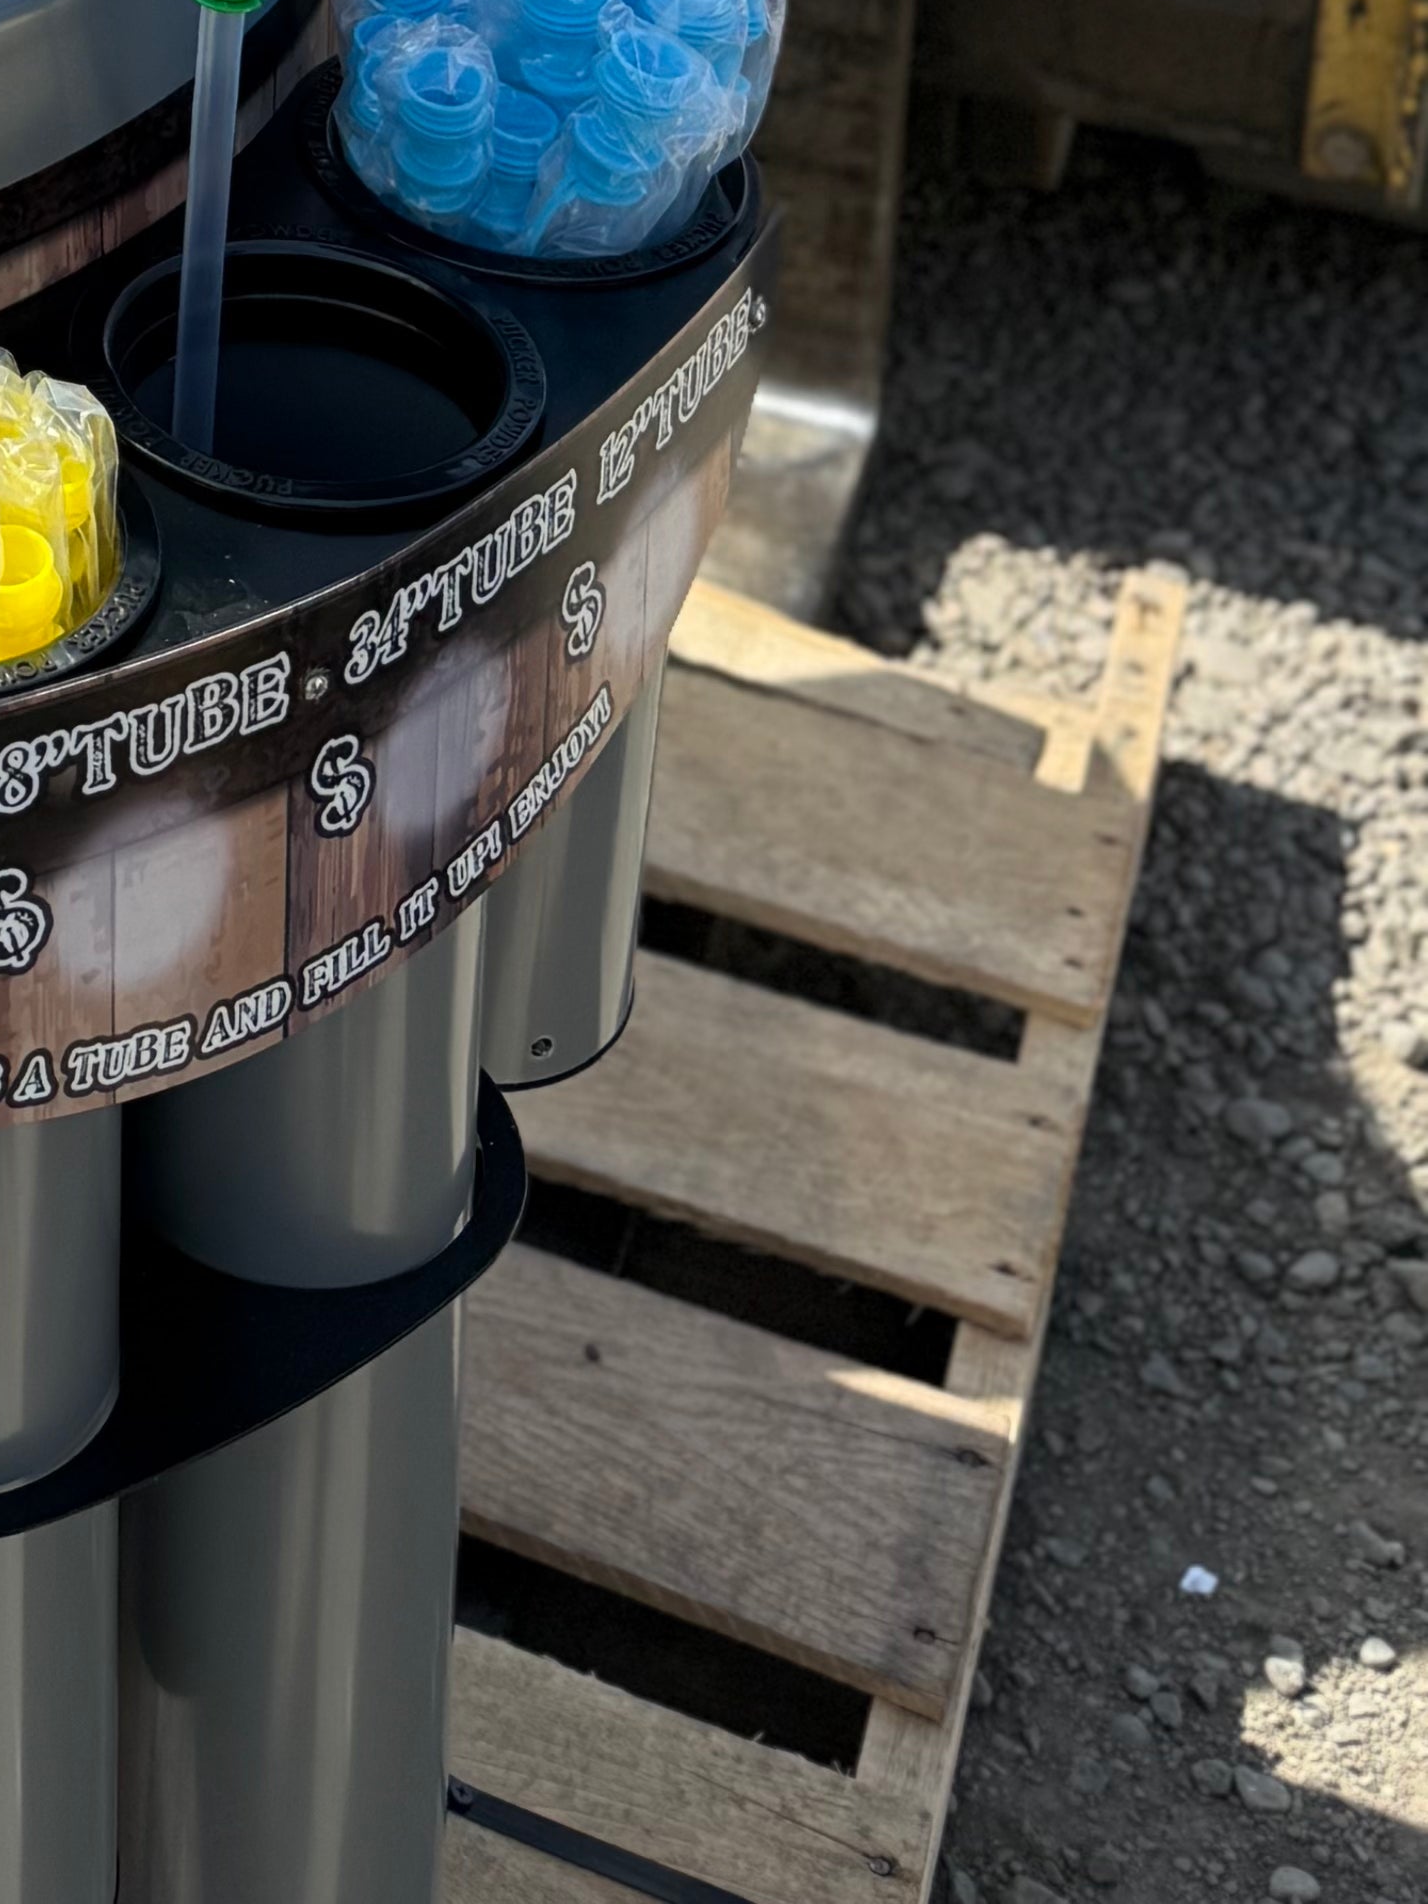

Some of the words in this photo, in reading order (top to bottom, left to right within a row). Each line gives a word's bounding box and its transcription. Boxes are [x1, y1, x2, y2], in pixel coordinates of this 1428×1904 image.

[312, 734, 370, 832] $
[562, 560, 604, 658] $
[13, 1055, 52, 1101] A
[67, 1021, 191, 1091] TUBE
[200, 980, 292, 1054] AND
[302, 919, 392, 1006] FILL
[399, 878, 439, 941] IT
[446, 833, 504, 898] UP!
[509, 689, 613, 837] ENJOY!
